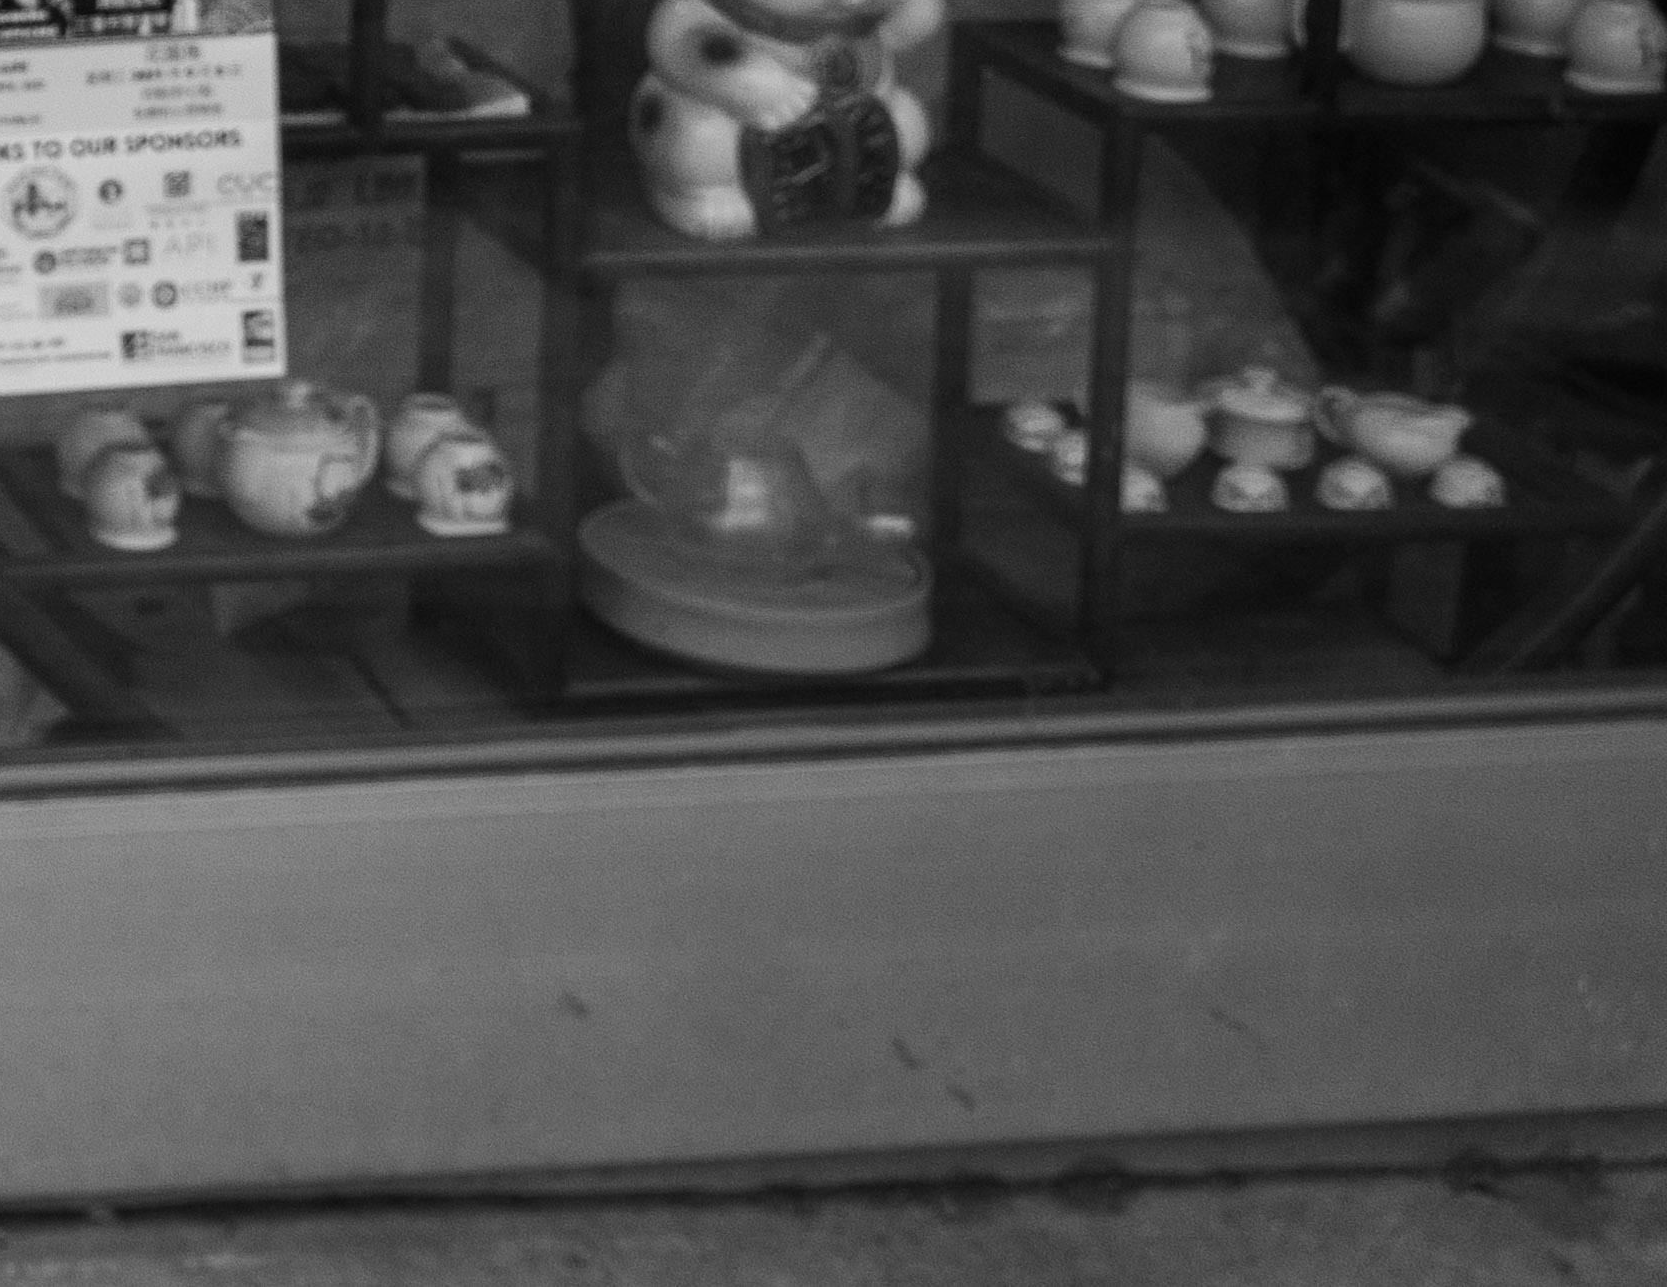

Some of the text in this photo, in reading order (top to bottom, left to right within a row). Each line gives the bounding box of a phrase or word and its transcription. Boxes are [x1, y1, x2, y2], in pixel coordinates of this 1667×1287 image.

[33, 139, 63, 159] TO
[70, 135, 117, 156] OUR
[124, 128, 242, 154] SPONSORS
